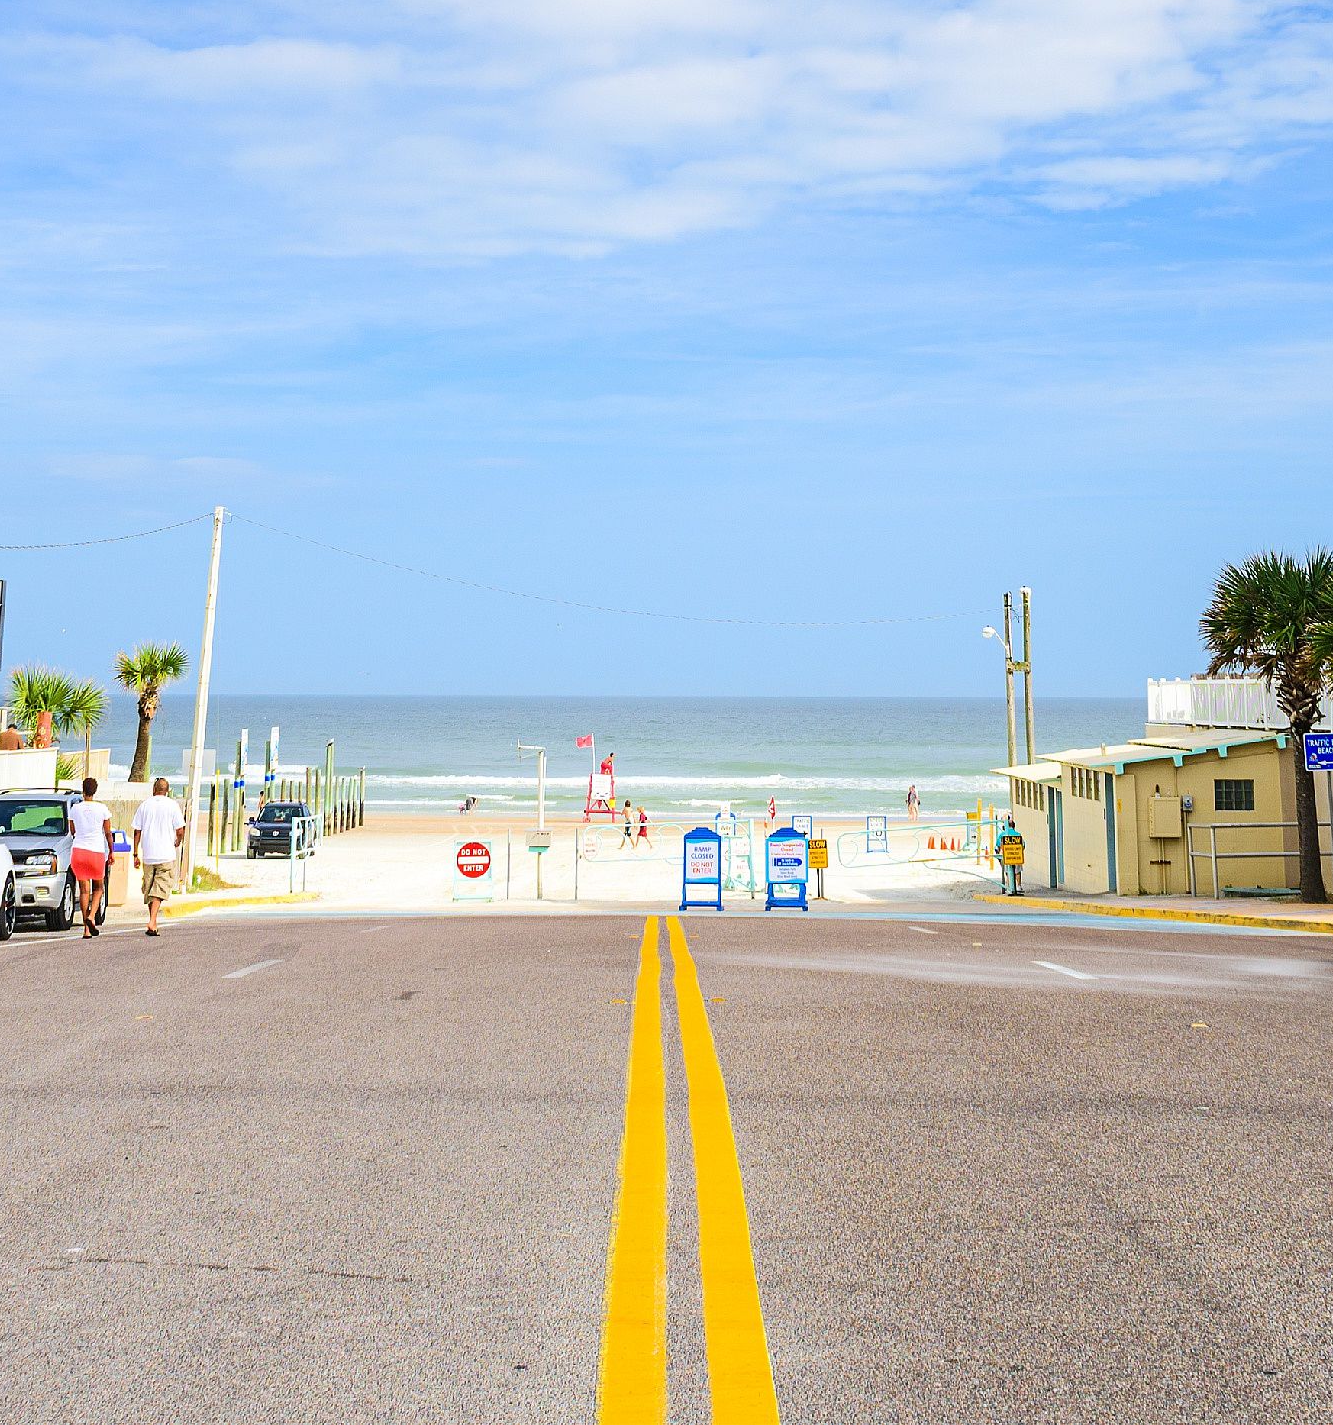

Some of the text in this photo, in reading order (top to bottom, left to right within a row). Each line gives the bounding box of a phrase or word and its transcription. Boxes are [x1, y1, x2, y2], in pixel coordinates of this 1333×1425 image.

[1307, 738, 1330, 746] TRAFFIC
[808, 840, 826, 849] SLOW
[1004, 836, 1022, 845] SLOW
[461, 848, 486, 856] DO NOT
[463, 864, 484, 872] ENTER
